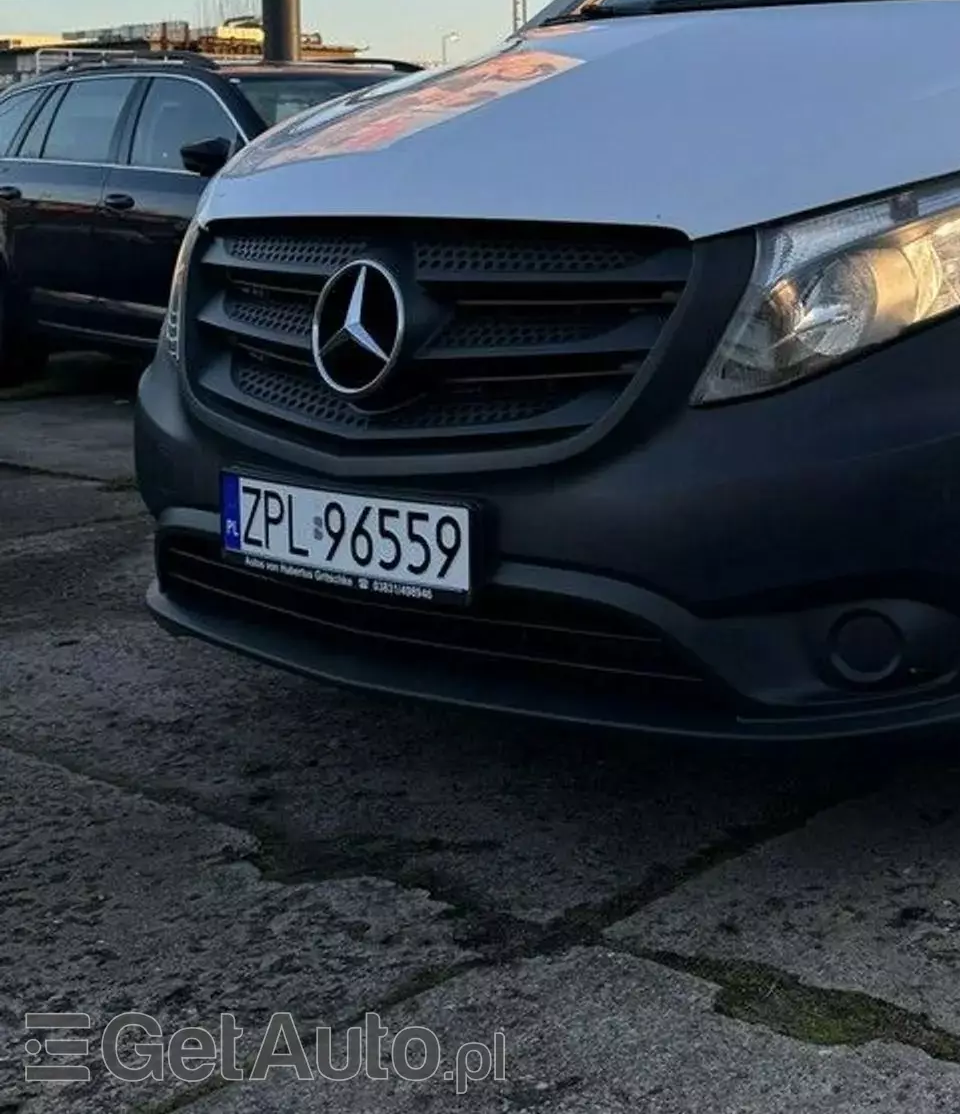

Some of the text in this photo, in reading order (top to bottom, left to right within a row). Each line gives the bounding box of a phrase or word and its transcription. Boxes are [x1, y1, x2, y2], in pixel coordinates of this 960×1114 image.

[226, 518, 239, 537] PL
[242, 486, 462, 579] ZPL 96559
